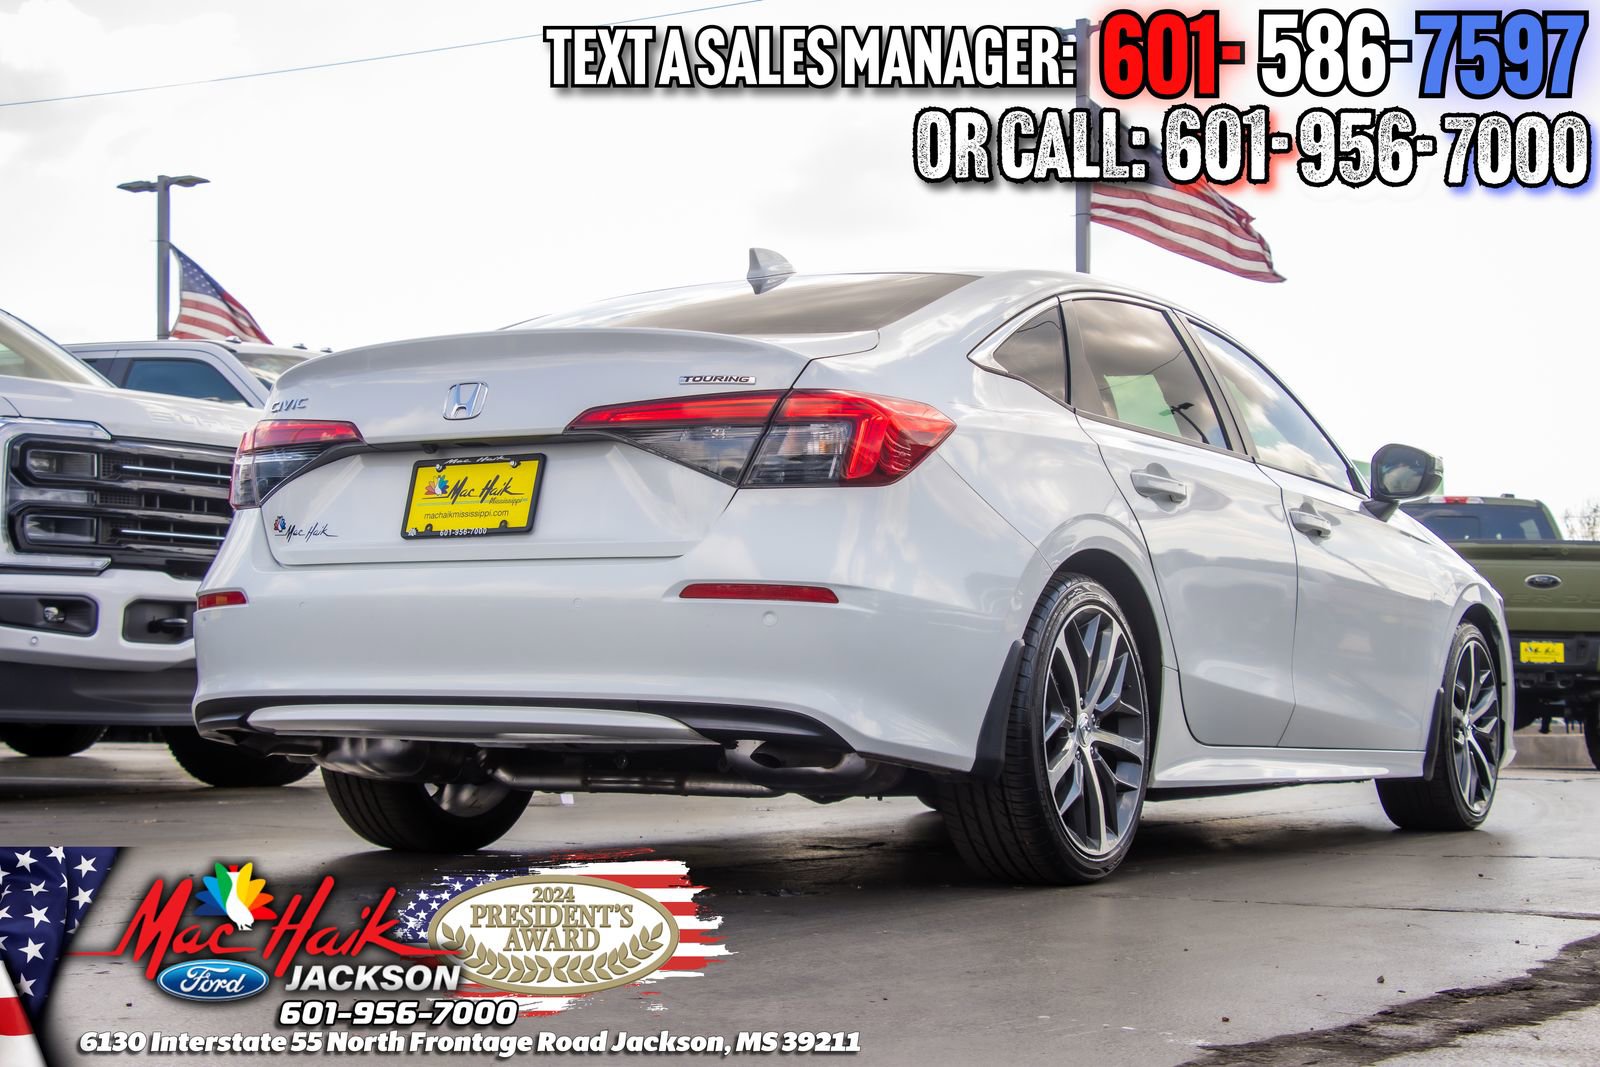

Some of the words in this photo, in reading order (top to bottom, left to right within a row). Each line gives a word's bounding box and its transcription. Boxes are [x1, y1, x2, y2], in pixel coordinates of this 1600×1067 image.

[683, 375, 750, 383] TOURING
[271, 398, 309, 413] CIVIC
[438, 476, 477, 504] Mac
[478, 475, 520, 503] Haik
[423, 509, 510, 520] machaikmississippi.com
[282, 525, 305, 542] Mac
[305, 522, 333, 542] Haik
[440, 527, 488, 537] 601-956-7000
